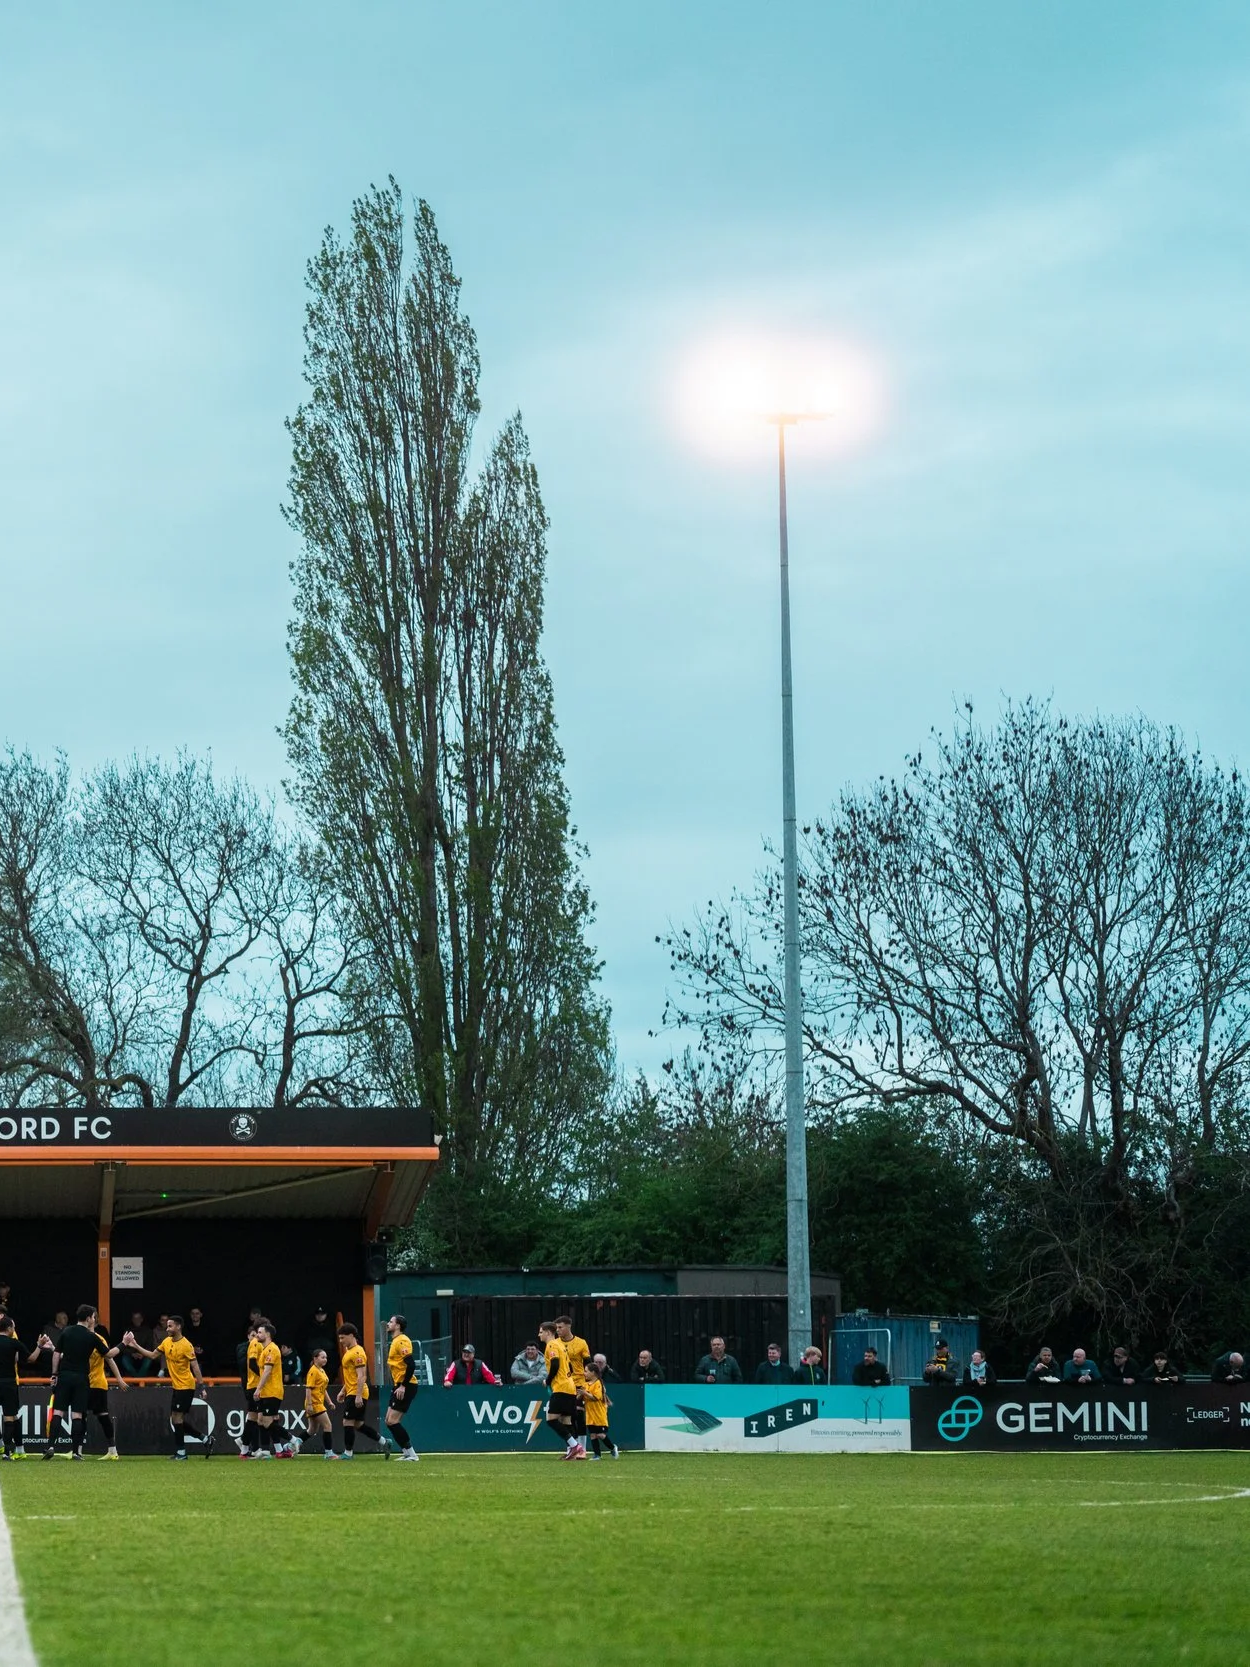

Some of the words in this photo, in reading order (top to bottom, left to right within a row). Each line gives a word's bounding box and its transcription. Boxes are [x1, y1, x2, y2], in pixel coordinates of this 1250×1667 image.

[74, 1117, 112, 1140] FC
[750, 1403, 811, 1434] IREN
[995, 1401, 1148, 1433] GEMINI
[1192, 1410, 1224, 1419] LEDGER
[1120, 1433, 1148, 1441] Exchange
